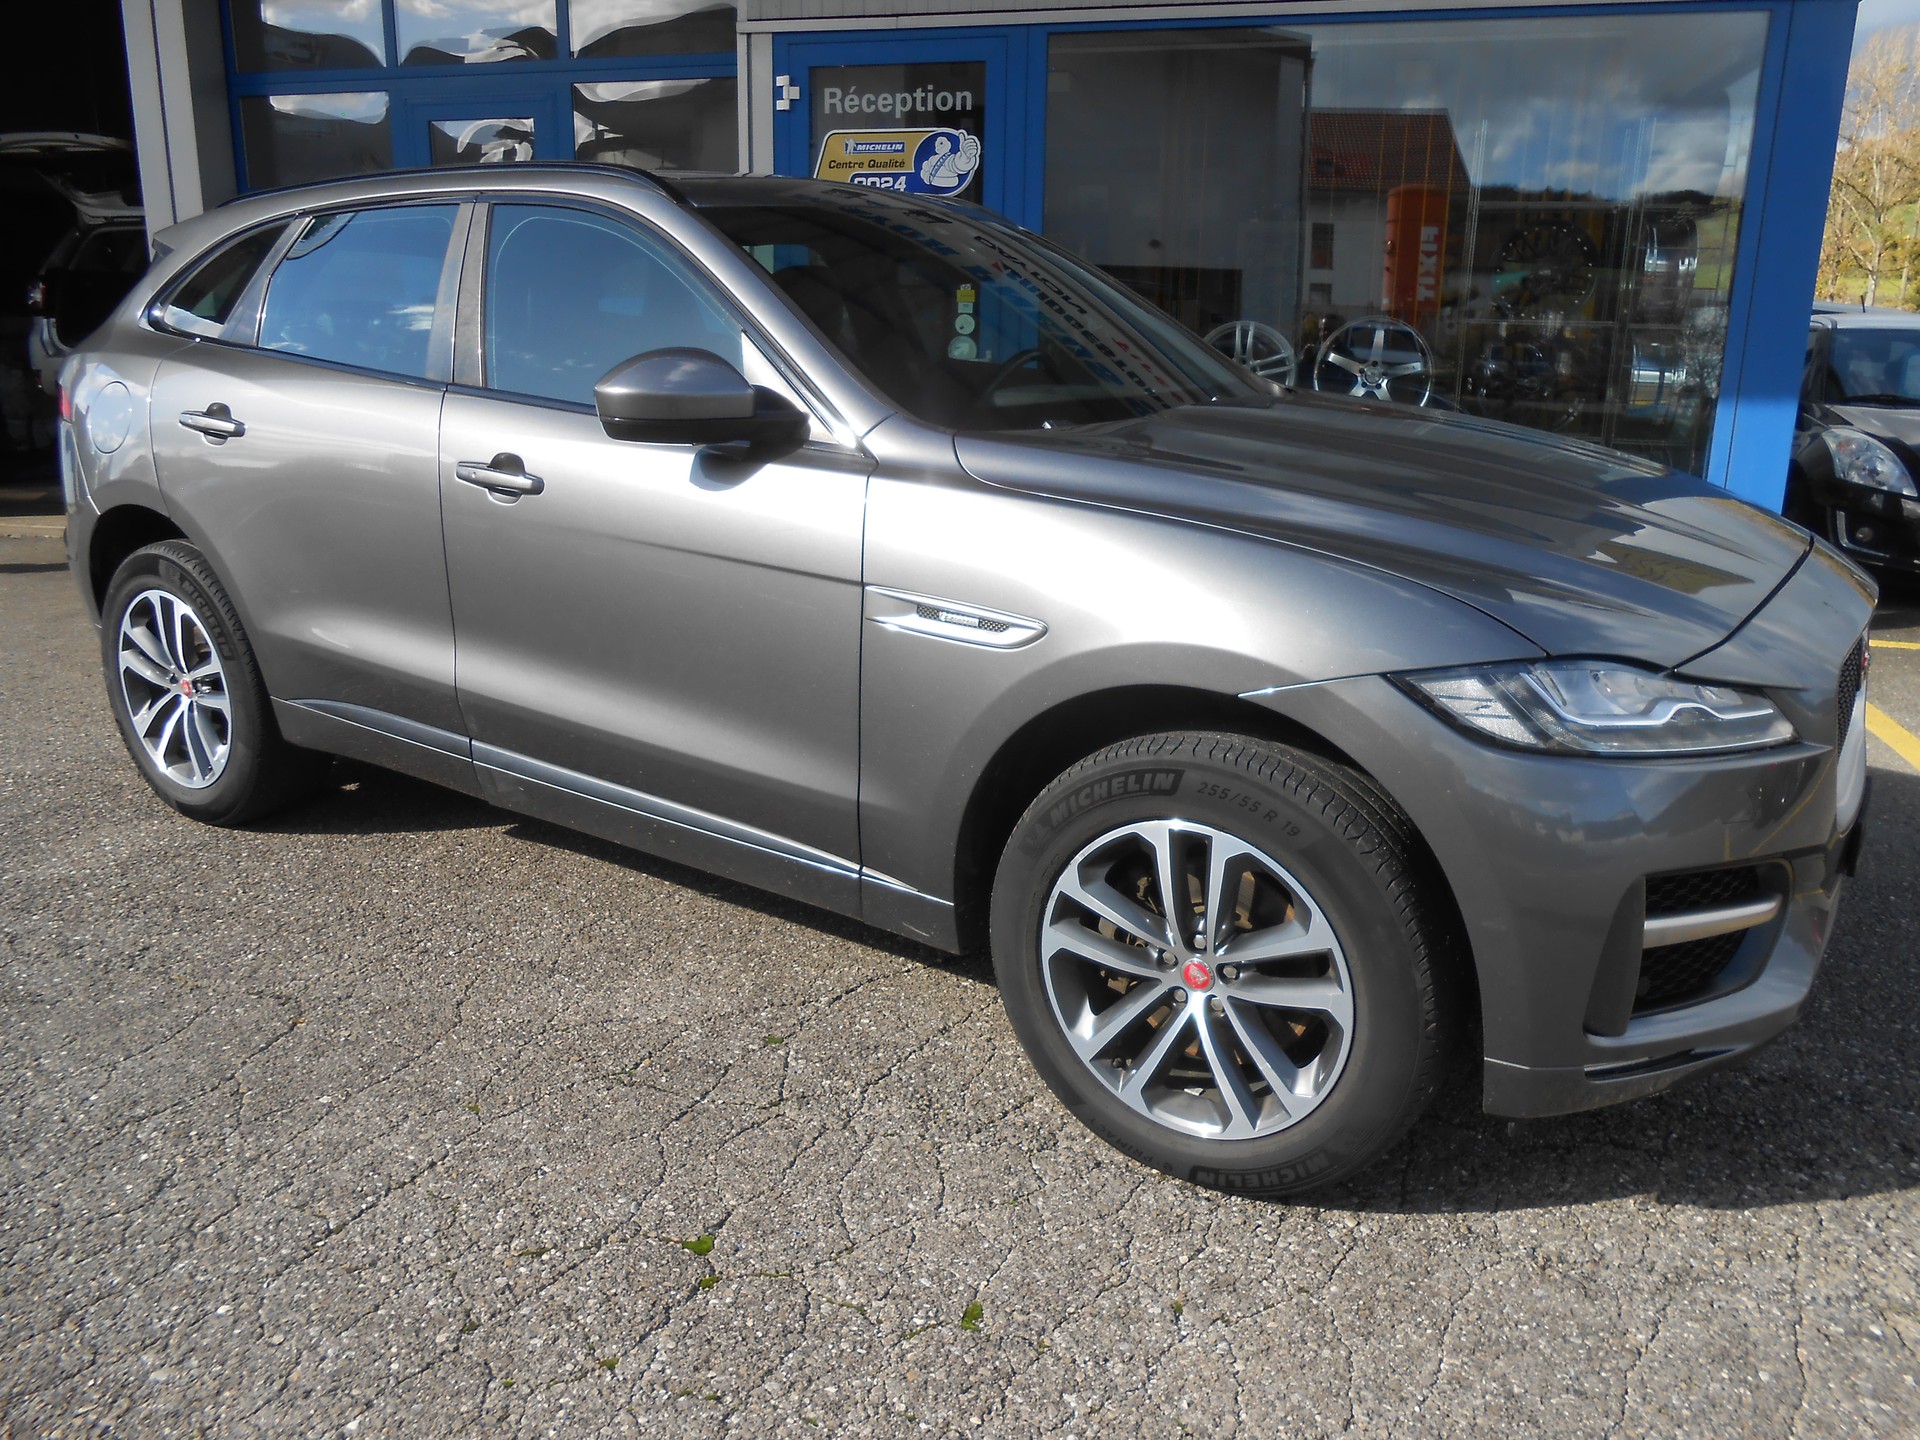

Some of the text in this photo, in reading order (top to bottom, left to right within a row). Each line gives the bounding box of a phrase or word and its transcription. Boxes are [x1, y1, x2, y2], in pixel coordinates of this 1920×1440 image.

[823, 85, 973, 118] Réception
[828, 159, 906, 169] Centre Qualité
[856, 143, 904, 151] MICHELIN
[1050, 772, 1175, 826] MICHELIN
[1196, 781, 1301, 839] 255/55 R 19
[1196, 1151, 1331, 1188] MICHELIN
